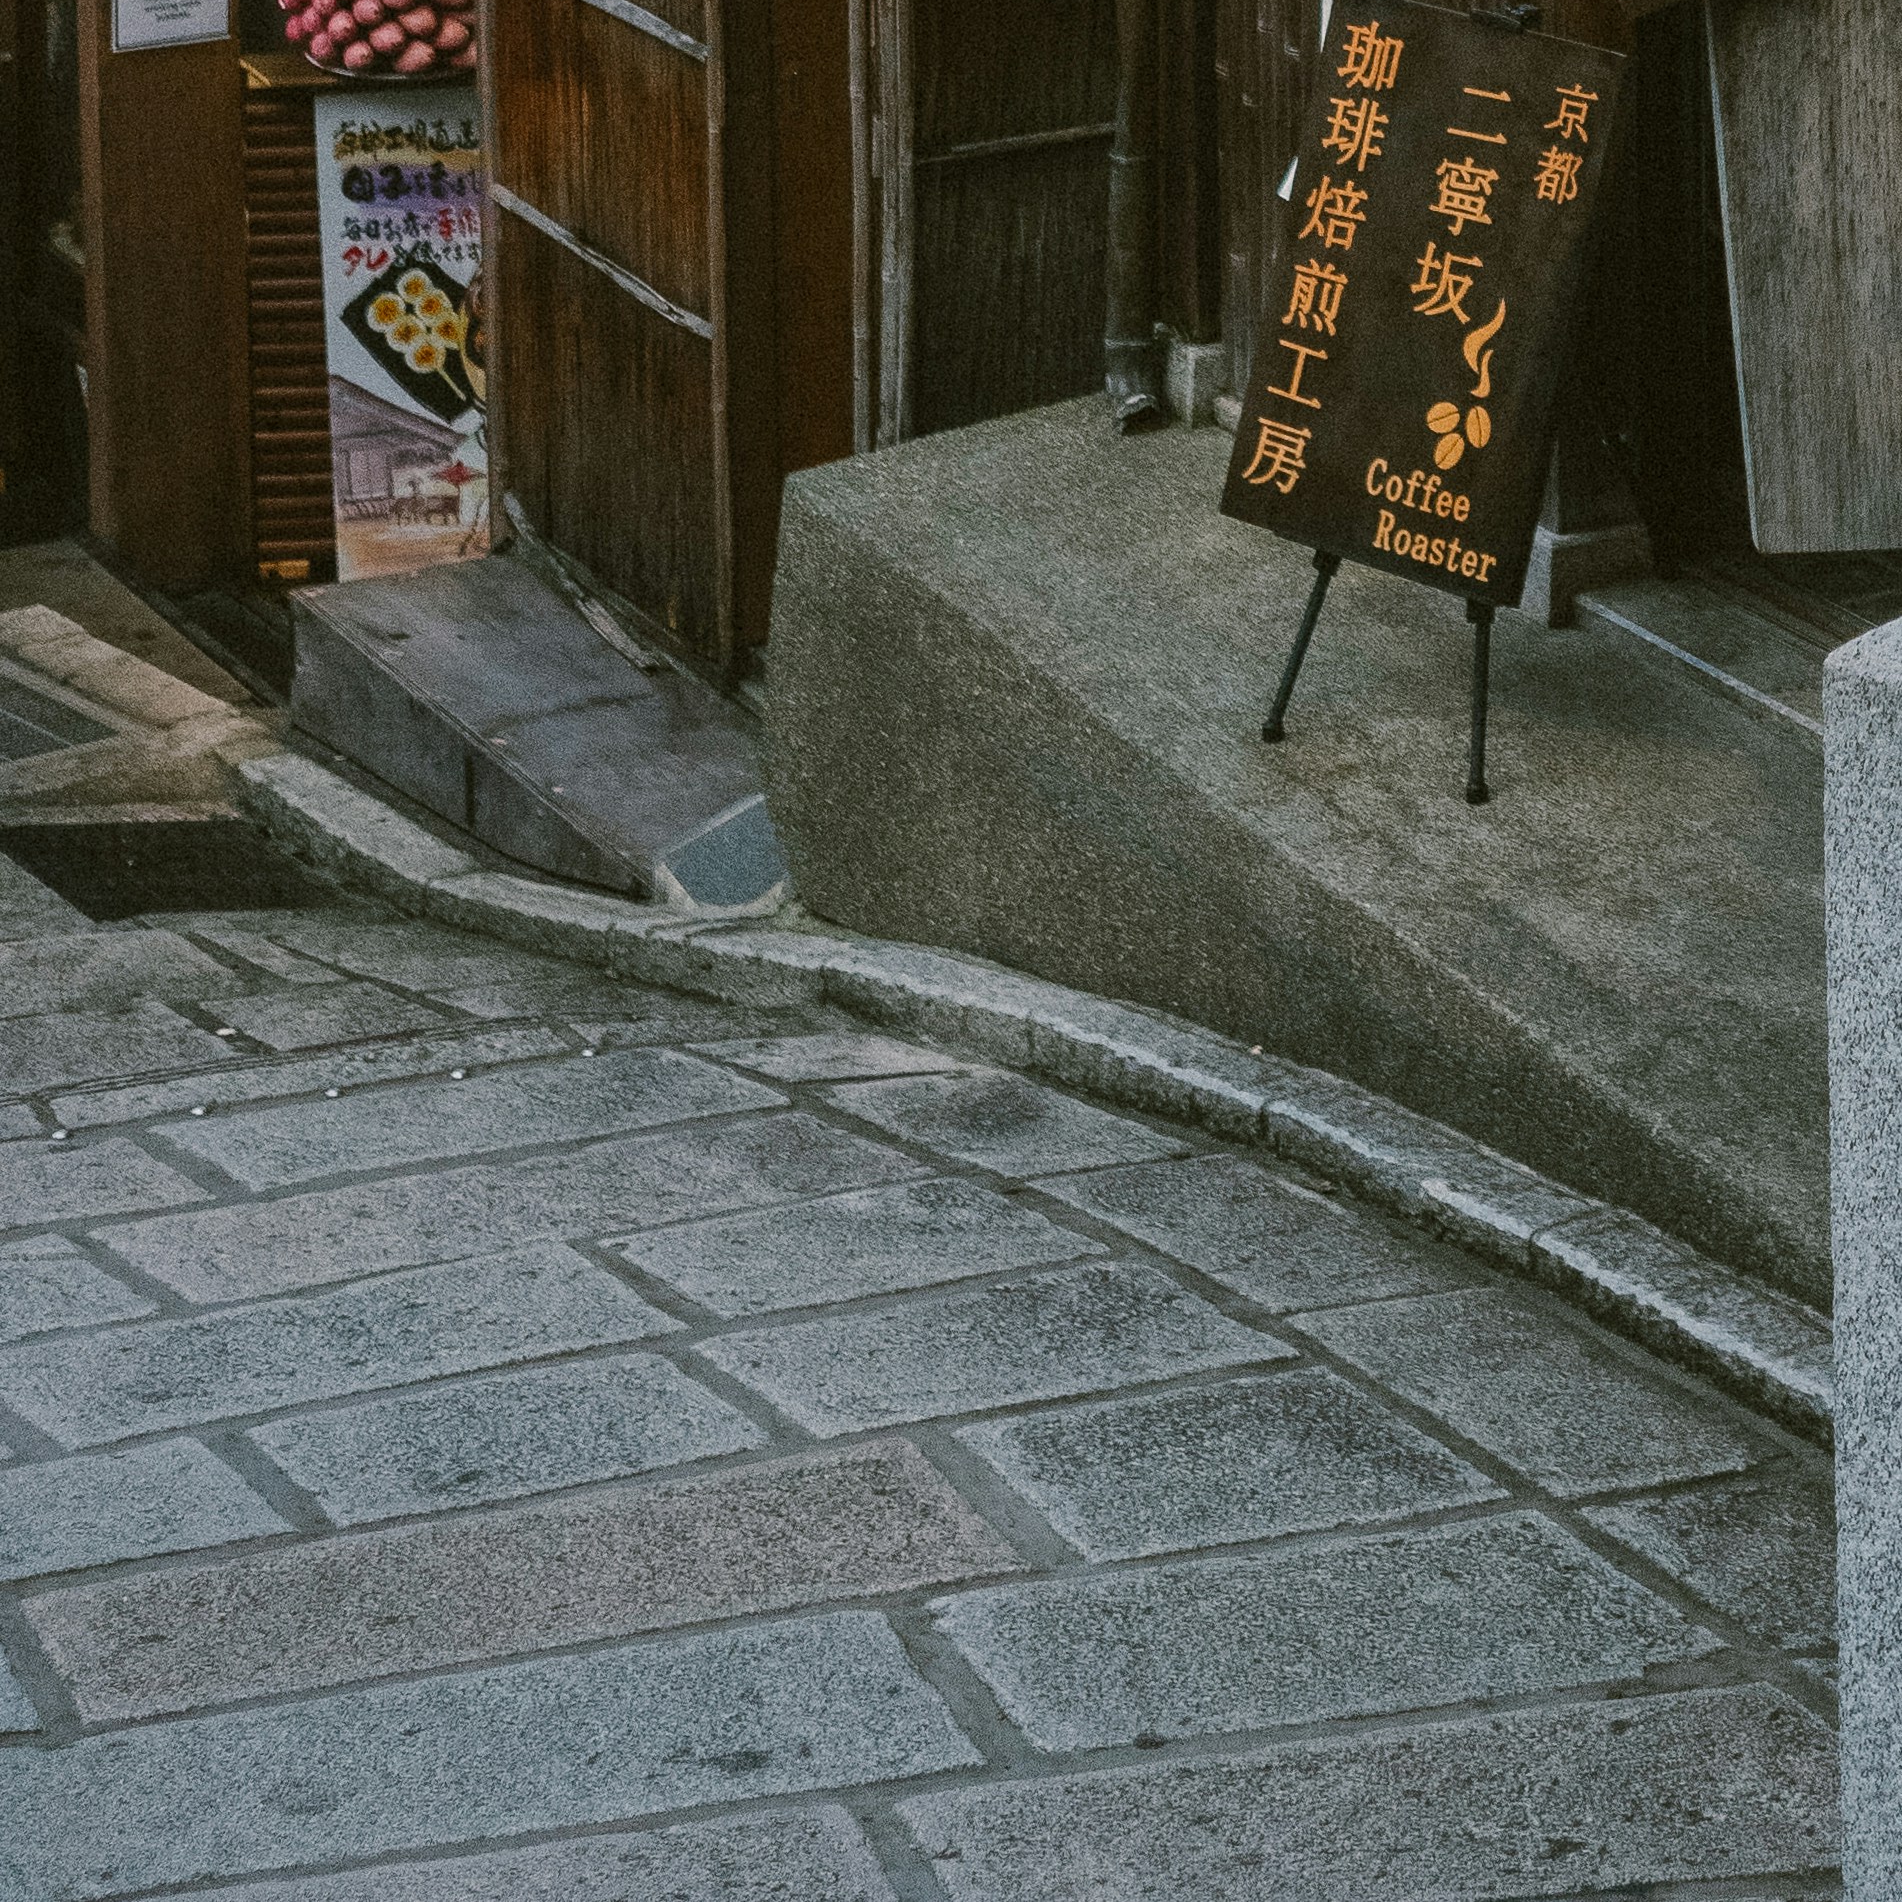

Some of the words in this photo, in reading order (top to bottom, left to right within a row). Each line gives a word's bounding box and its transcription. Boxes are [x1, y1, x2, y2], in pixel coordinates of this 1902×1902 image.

[1409, 85, 1513, 326] 二寧坂
[1533, 83, 1599, 206] 京都
[1241, 19, 1405, 496] 珈琲焙煎工房
[1365, 457, 1471, 524] Coffee
[1374, 509, 1498, 584] Roaster
